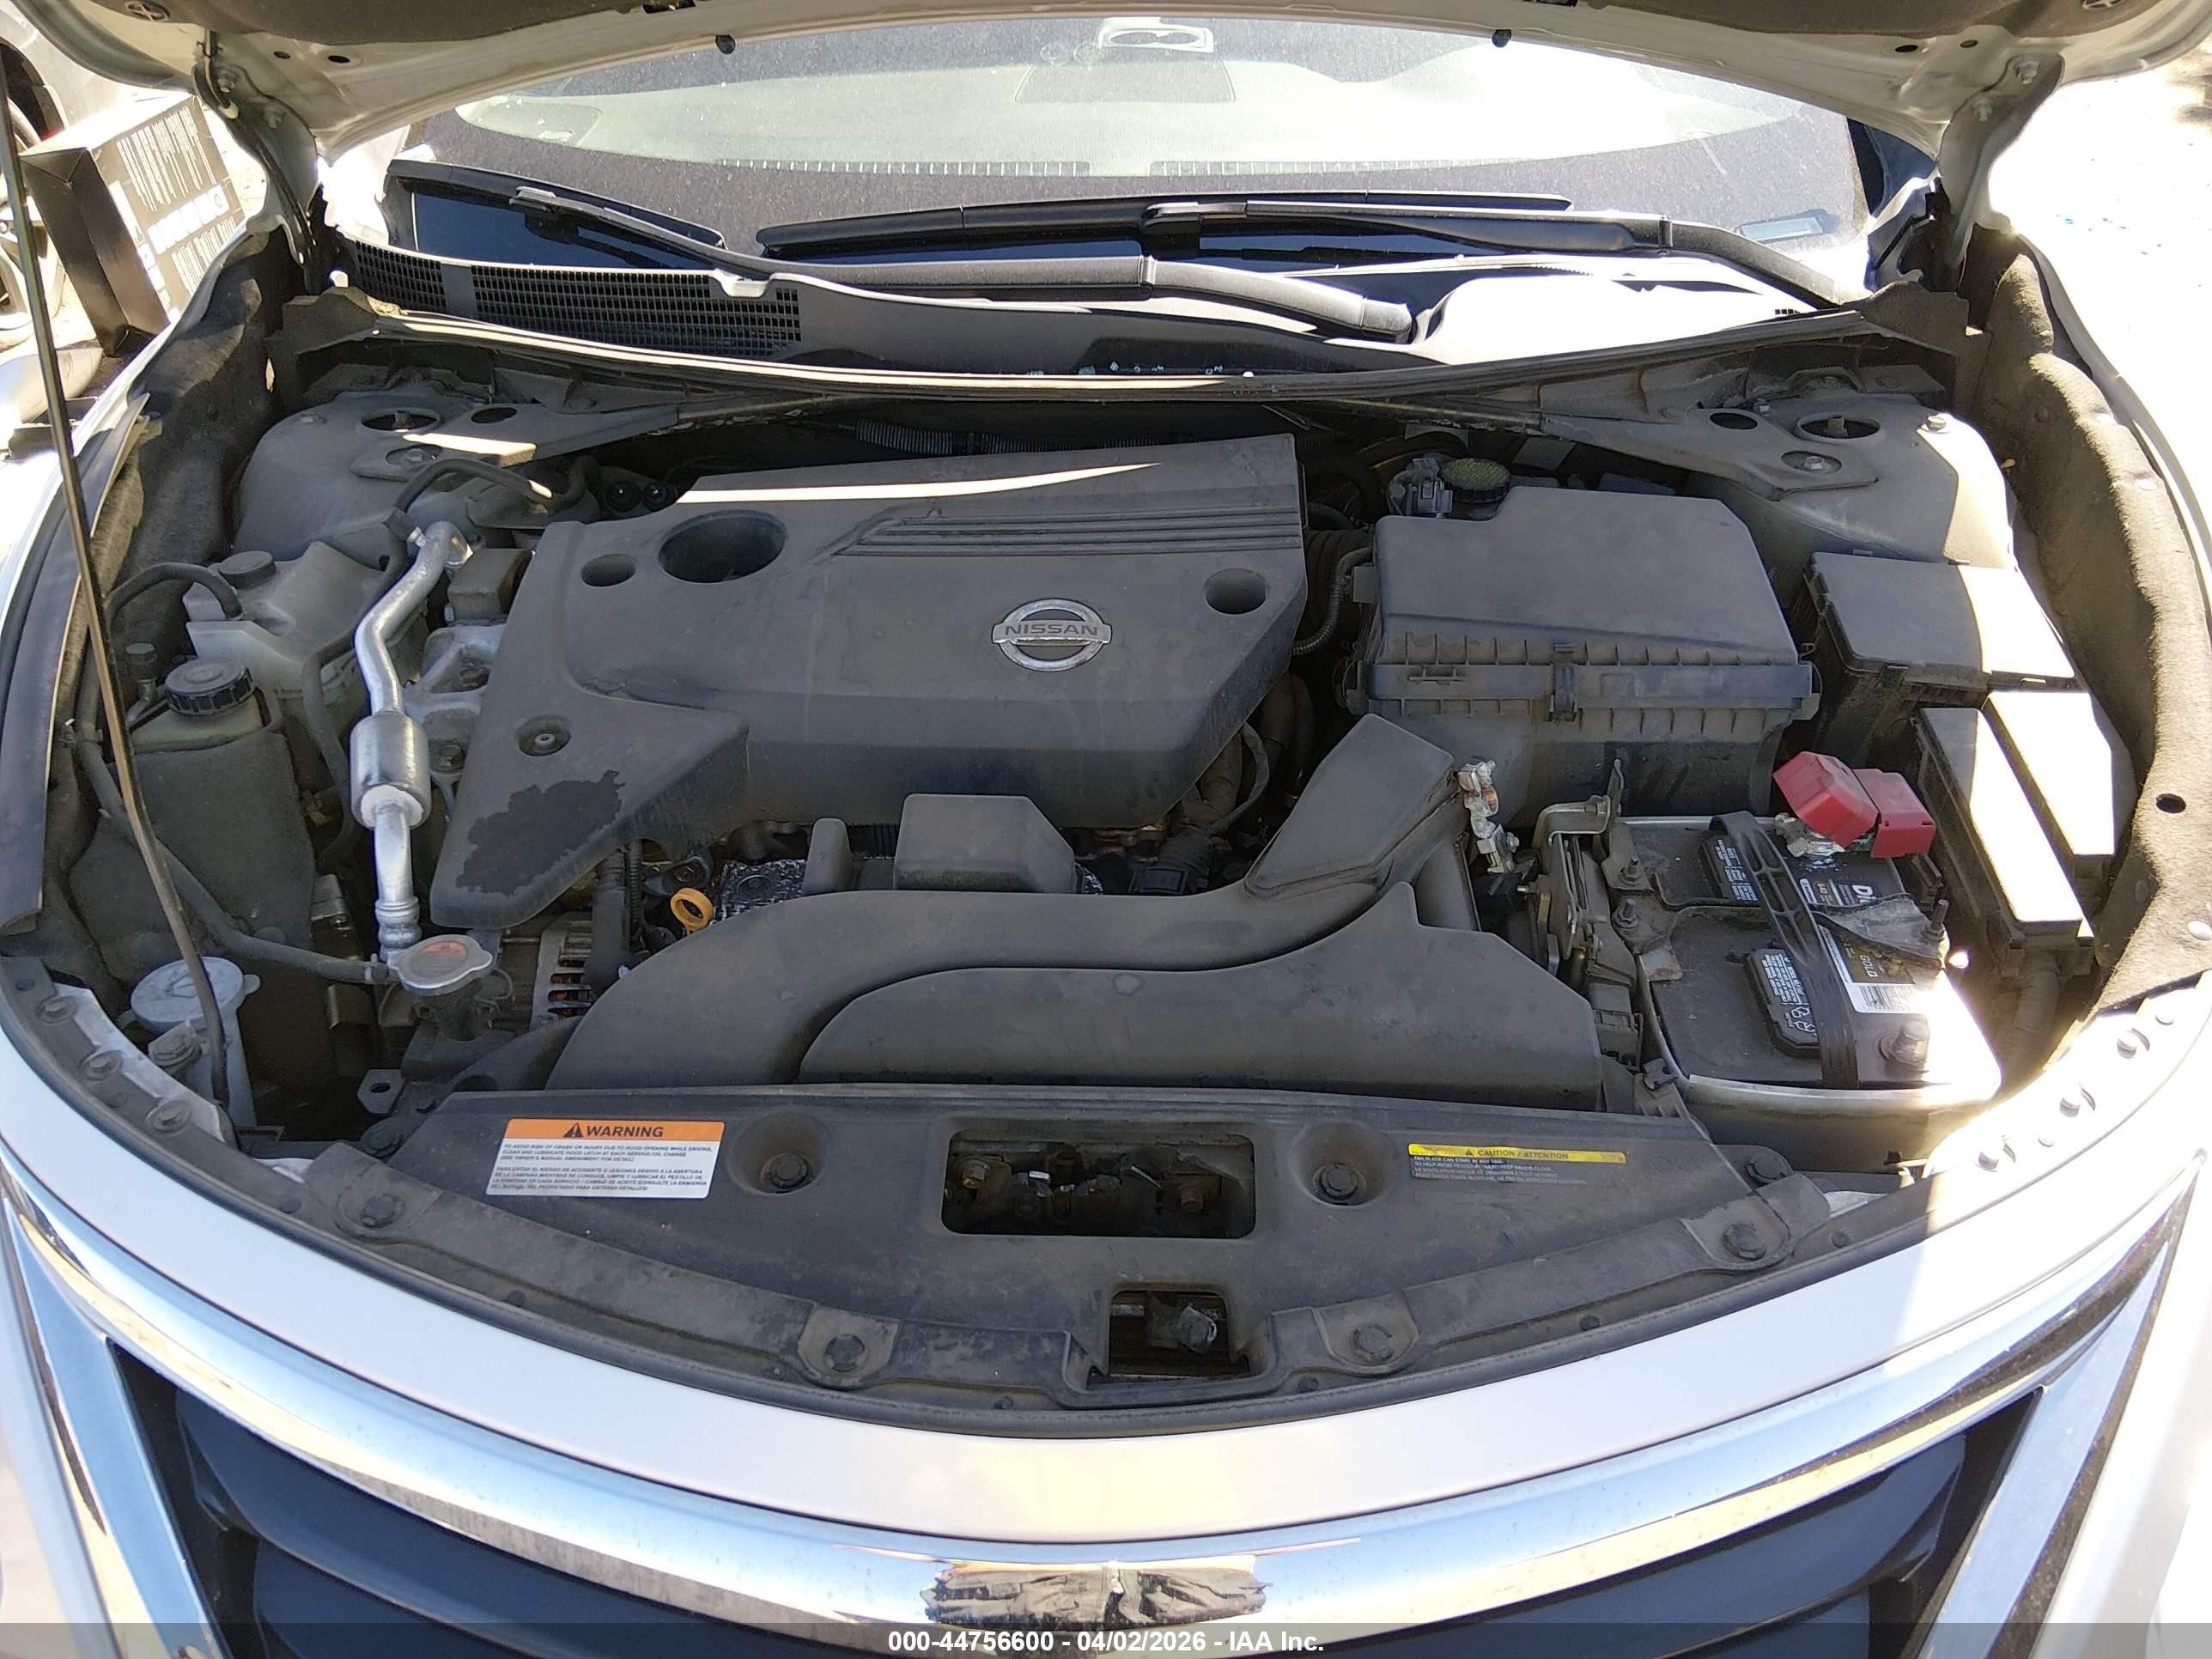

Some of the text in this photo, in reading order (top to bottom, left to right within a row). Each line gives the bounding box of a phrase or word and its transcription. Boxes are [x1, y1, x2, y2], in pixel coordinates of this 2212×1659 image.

[1005, 623, 1098, 636] NISSAN
[1859, 954, 1878, 977] GOLD
[586, 1126, 664, 1138] WARNING
